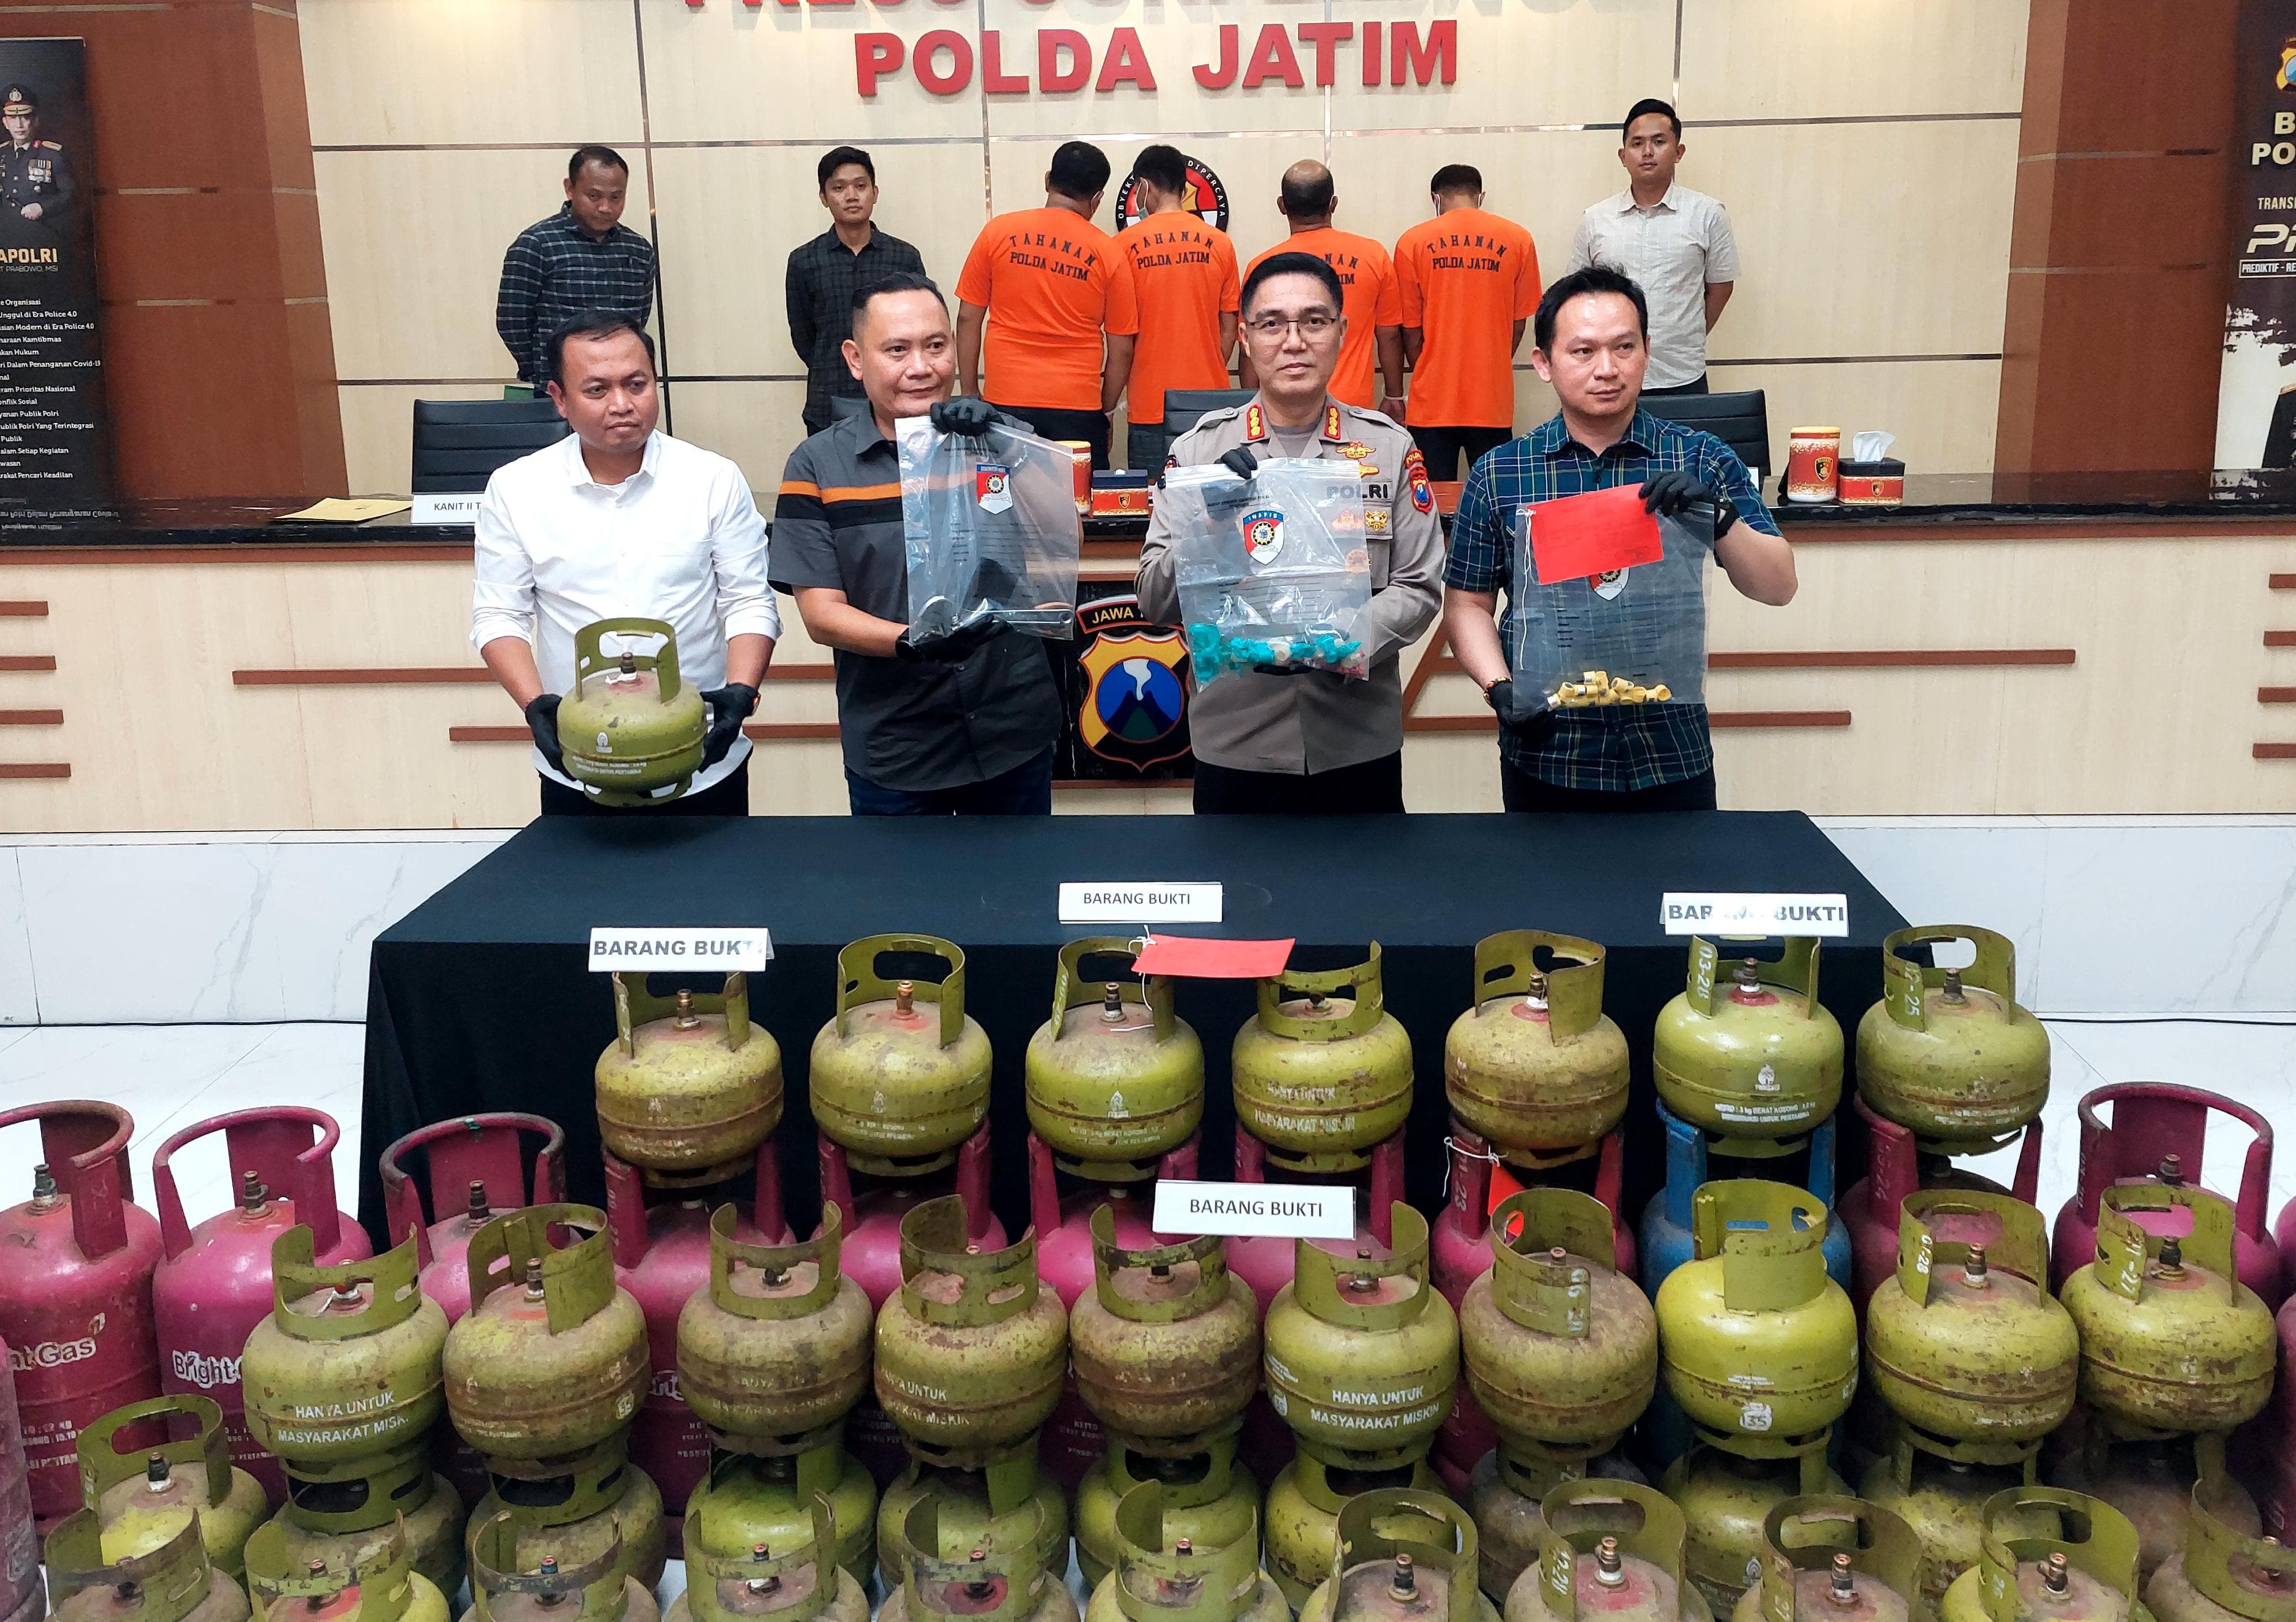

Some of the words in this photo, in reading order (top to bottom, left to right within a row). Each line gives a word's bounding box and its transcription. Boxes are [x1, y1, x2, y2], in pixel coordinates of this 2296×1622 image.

[855, 29, 1158, 98] POLDA
[1192, 19, 1457, 89] JATIM
[1188, 160, 1226, 218] DIPERCAYA
[1009, 233, 1096, 267] TAHANAN
[1130, 231, 1214, 255] TAHANAN
[1427, 235, 1508, 258] TAHANAN
[1009, 252, 1046, 269] POLDA
[1051, 261, 1089, 281] JATIM
[1137, 255, 1172, 269] POLDA
[1176, 252, 1210, 265] JATIM
[1432, 257, 1465, 269] POLDA
[1468, 257, 1500, 272] JATIM
[2242, 263, 2279, 273] PREDIKTIF
[1327, 484, 1388, 499] POLRI
[1092, 607, 1134, 624] JAWA
[1083, 893, 1144, 905] BARANG
[1149, 893, 1190, 905] BUKTI
[594, 940, 686, 956] BARANG
[1320, 1116, 1355, 1132] MISIN
[1190, 1199, 1264, 1215] BARANG
[1271, 1201, 1322, 1217] BUKTI
[907, 1381, 947, 1401] UNTUK
[1332, 1389, 1379, 1406] HANYA
[1382, 1386, 1425, 1406] UNTUK
[347, 1391, 395, 1413] UNTUK
[1311, 1408, 1399, 1429] MASYARAKAT
[1404, 1402, 1440, 1426] MISKIN
[279, 1425, 370, 1444] MASYARAKAT
[374, 1416, 409, 1434] MISK
